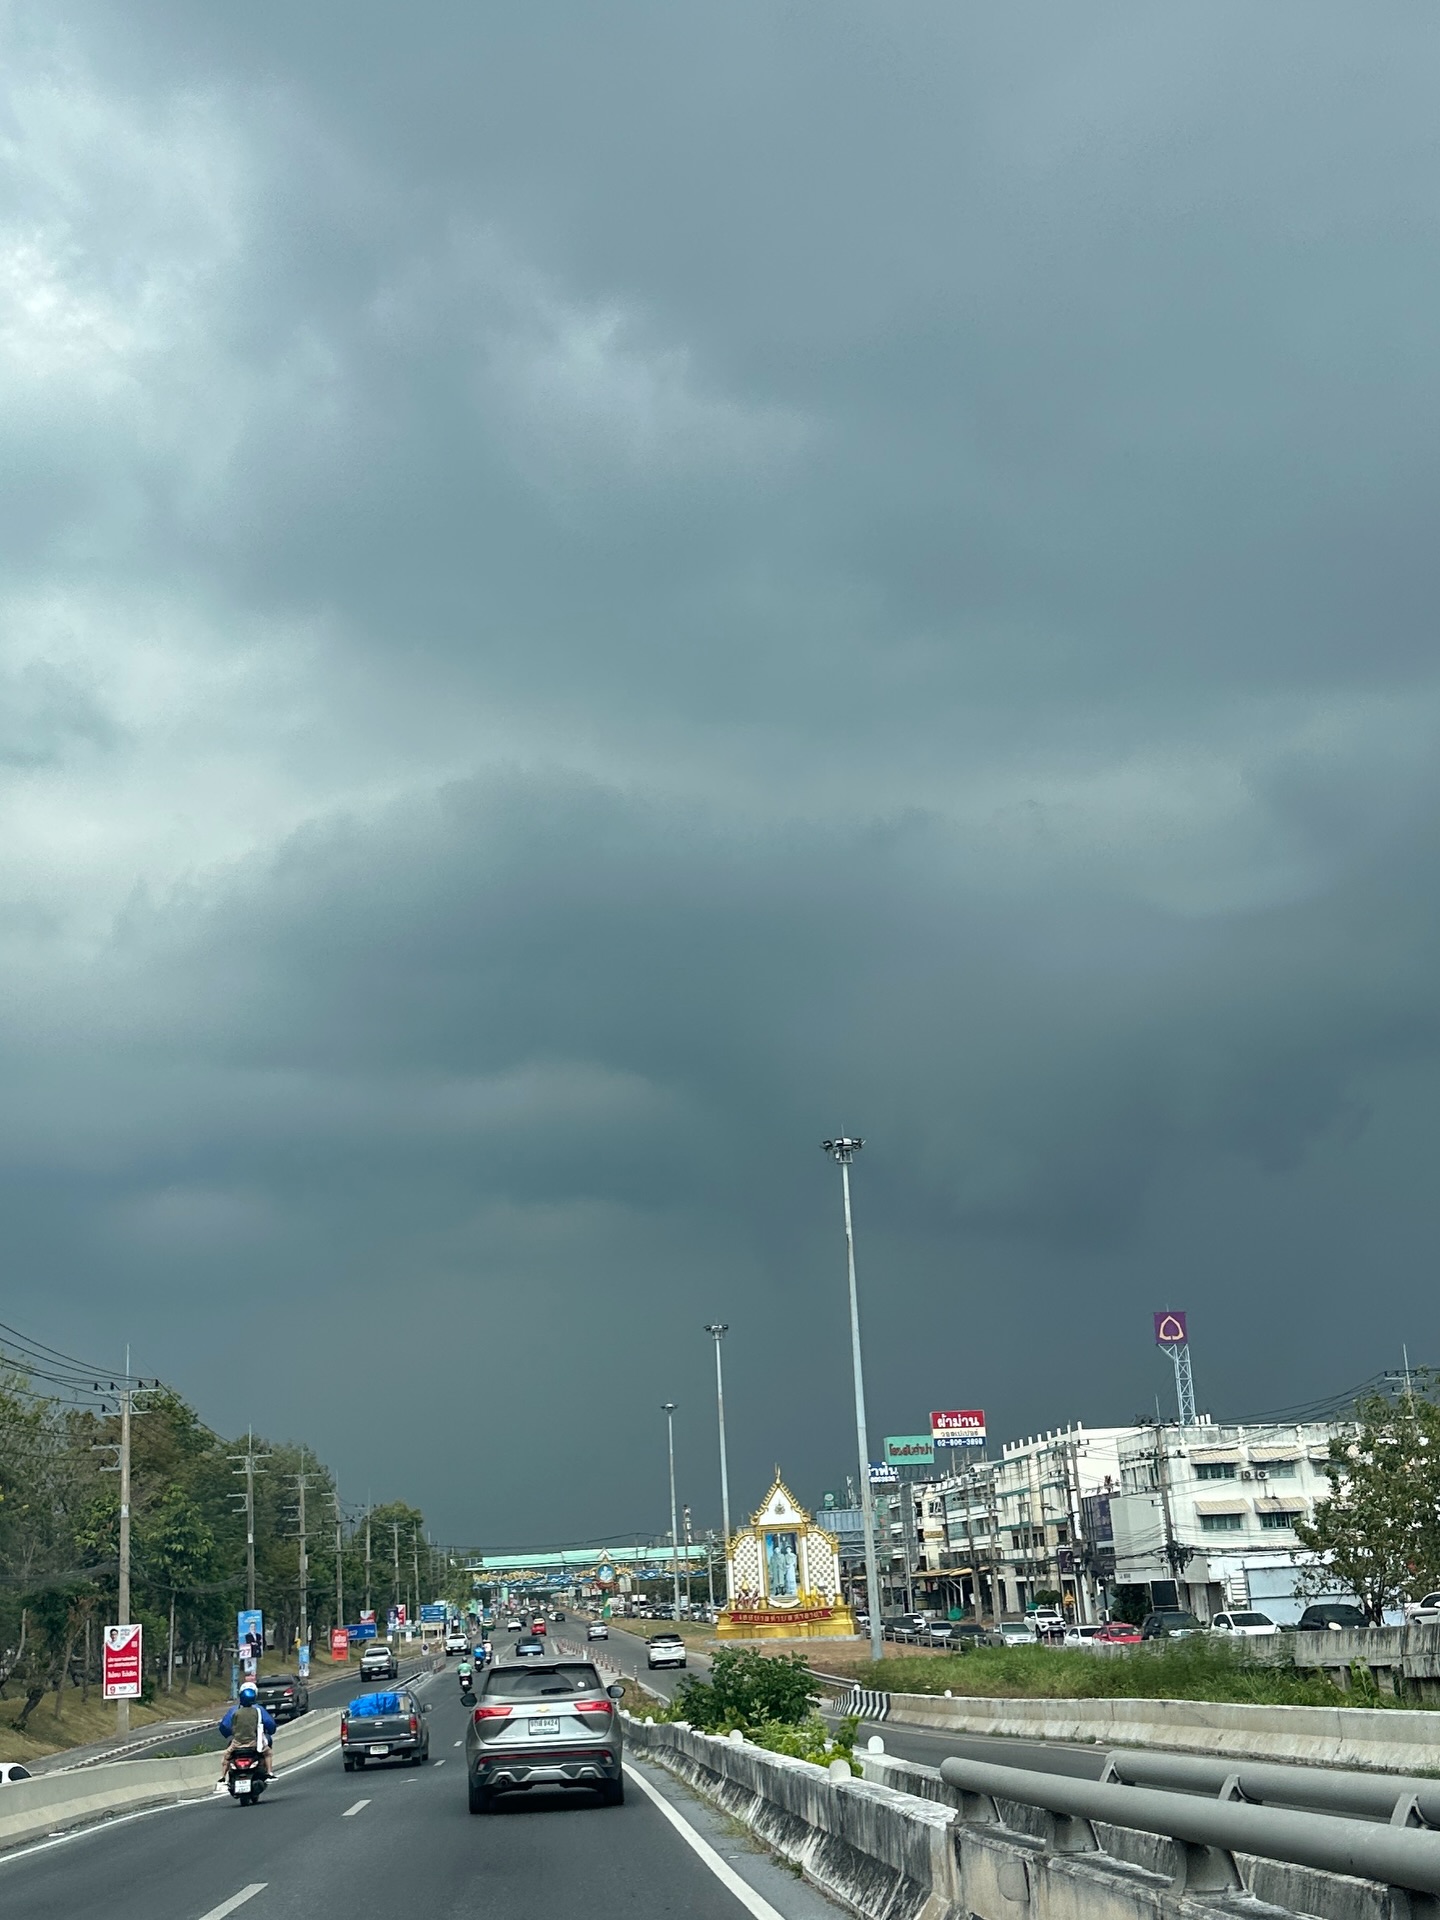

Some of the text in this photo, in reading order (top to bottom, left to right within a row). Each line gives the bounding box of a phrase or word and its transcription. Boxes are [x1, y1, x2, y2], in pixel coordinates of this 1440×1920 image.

[937, 1413, 980, 1428] ผ้าม่าน
[241, 1649, 251, 1657] 27
[109, 1685, 116, 1695] 9
